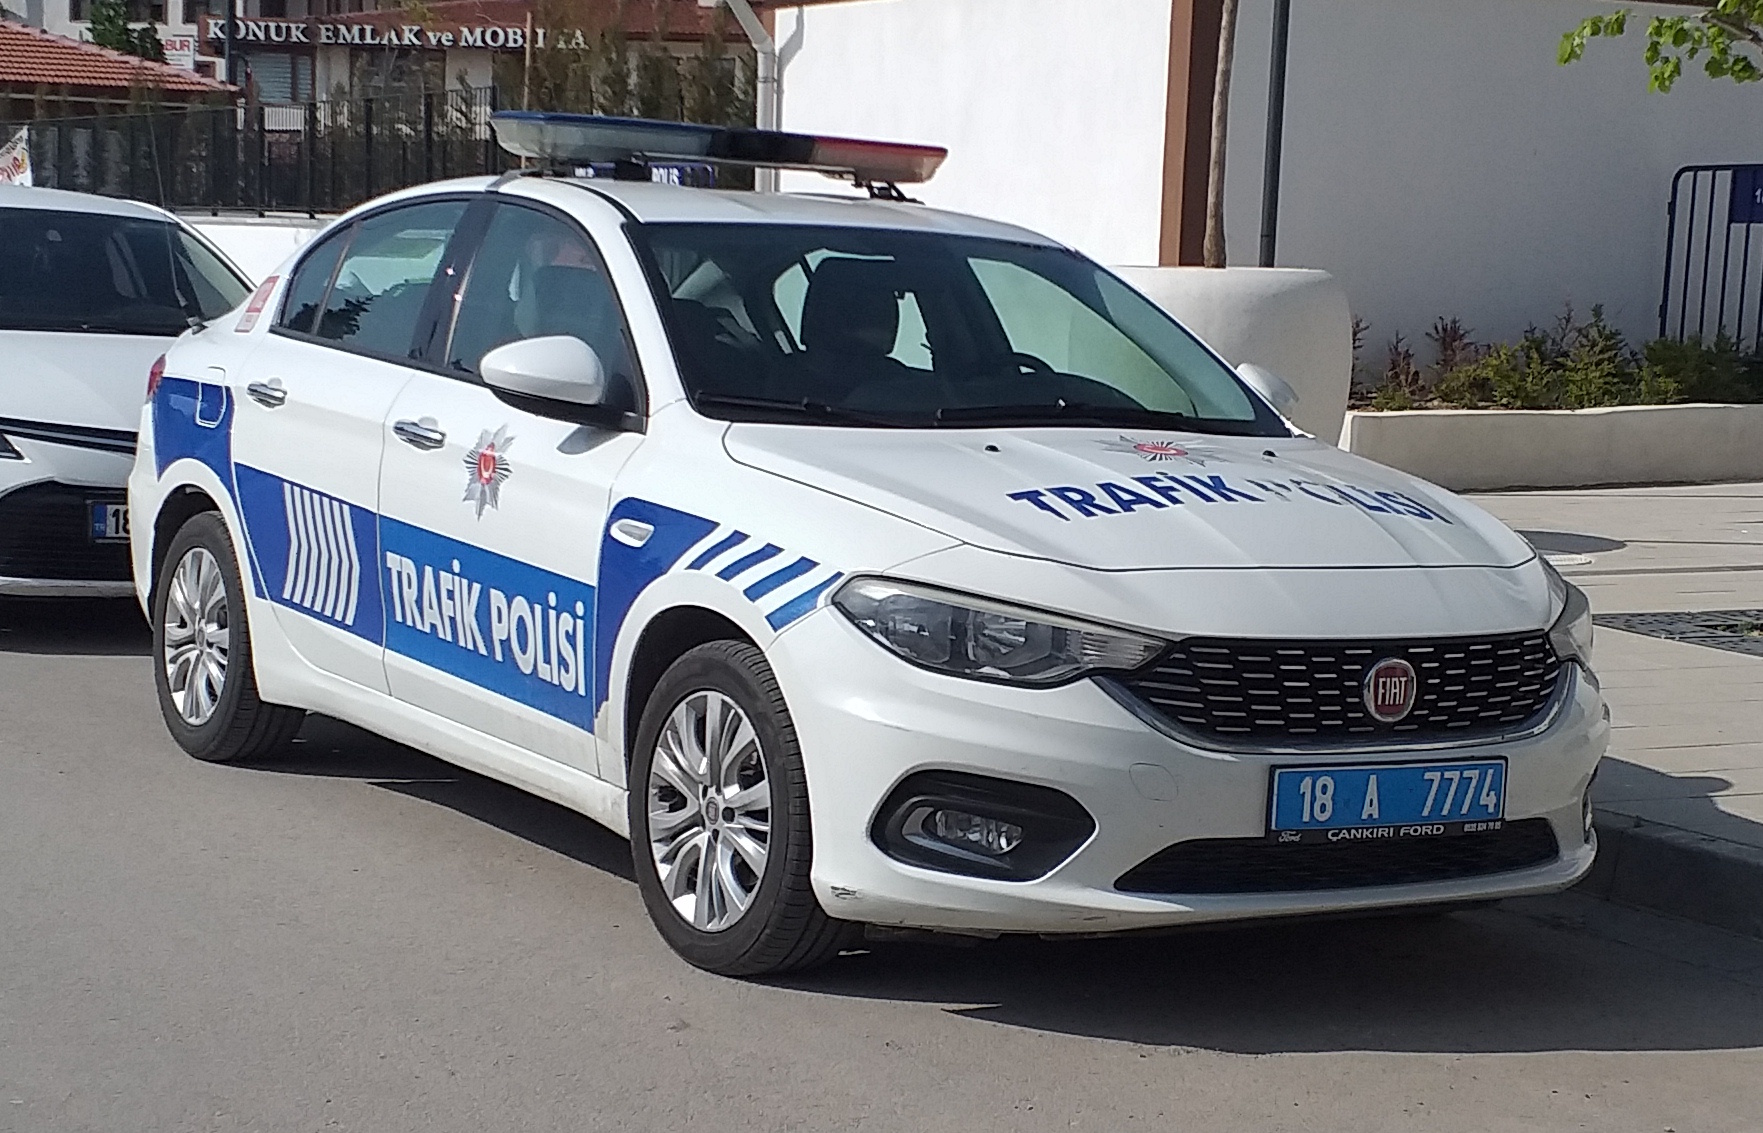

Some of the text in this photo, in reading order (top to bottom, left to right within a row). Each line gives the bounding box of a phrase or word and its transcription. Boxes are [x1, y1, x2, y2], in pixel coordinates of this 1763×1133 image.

[207, 19, 310, 43] KONUK
[318, 24, 423, 46] EMLAK
[426, 31, 454, 46] ve
[1006, 471, 1265, 521] TRAFİK
[386, 551, 586, 697] TRAFİK POLİSİ
[1377, 676, 1408, 706] FIAT
[1299, 768, 1497, 822] 18 A 7774
[1278, 830, 1302, 843] Ford
[1327, 824, 1445, 842] ÇANKIRI FORD
